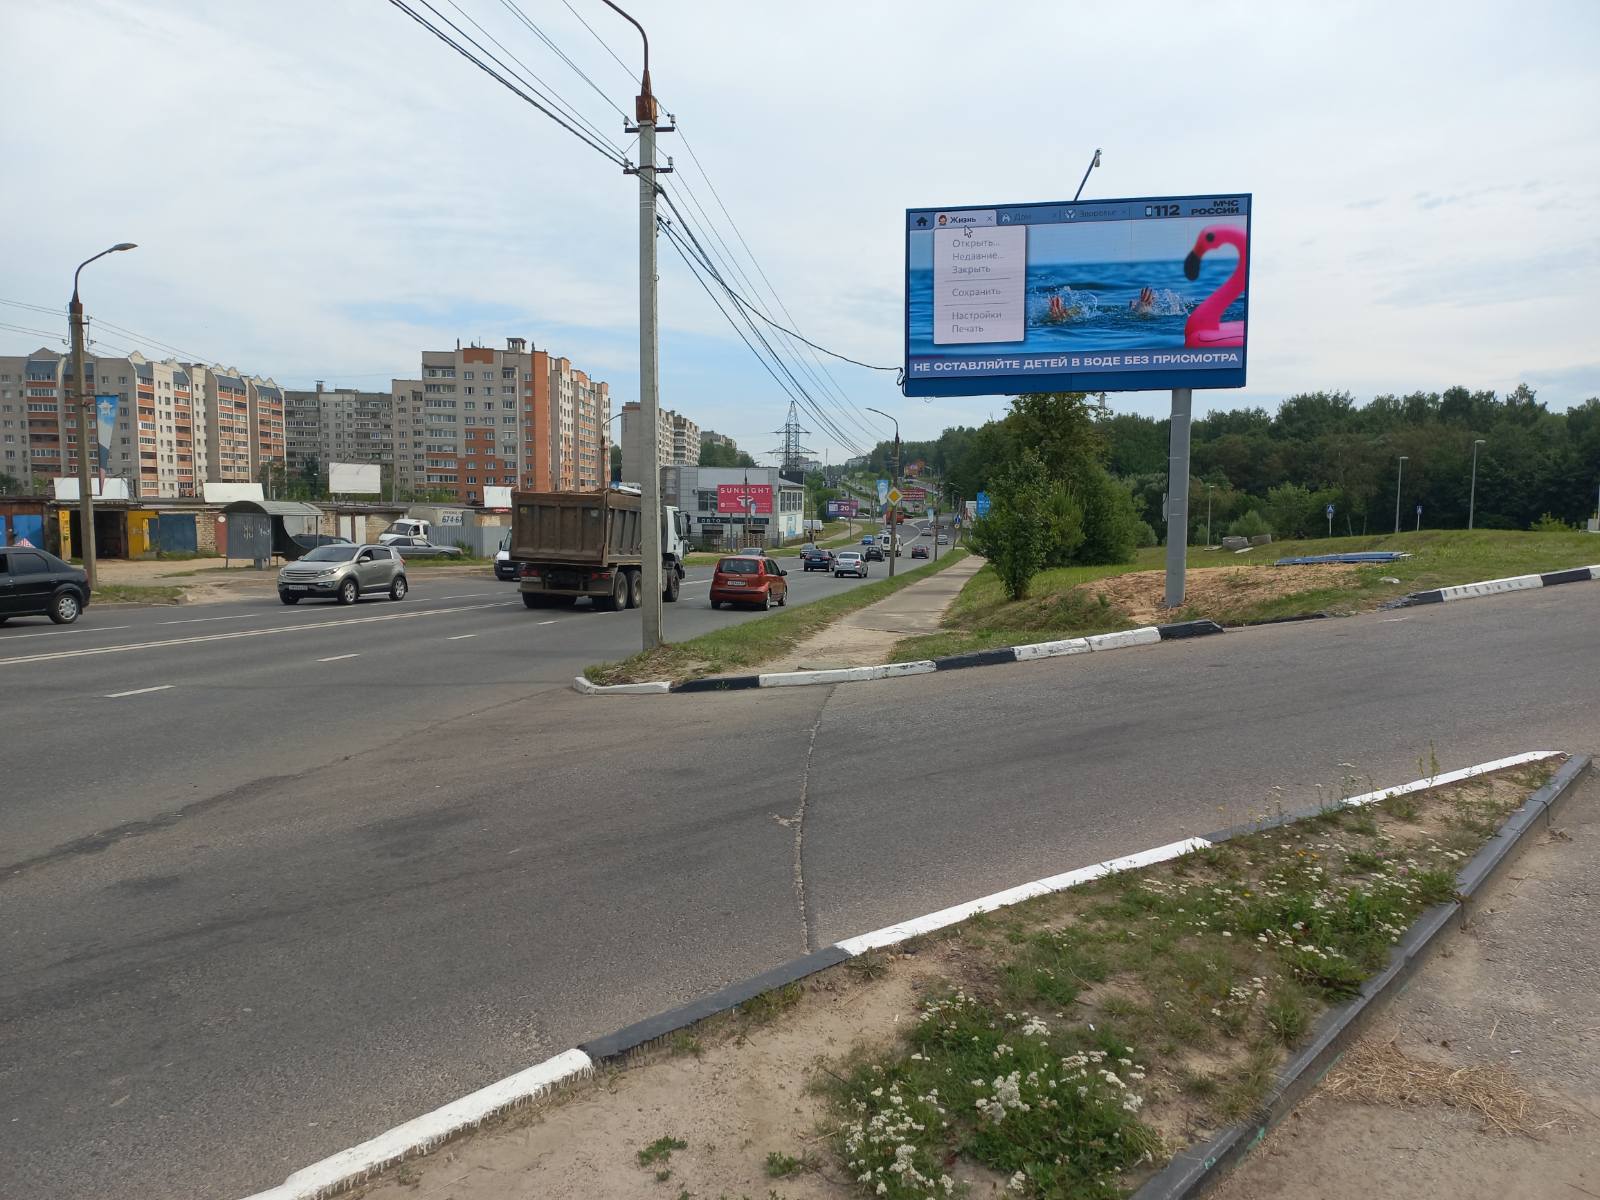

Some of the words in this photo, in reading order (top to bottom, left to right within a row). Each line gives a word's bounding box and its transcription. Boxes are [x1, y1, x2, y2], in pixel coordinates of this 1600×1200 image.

[1154, 204, 1180, 216] 112
[1191, 207, 1239, 216] РОССИИ
[950, 215, 977, 225] Жизнь
[952, 265, 990, 275] Закрыть
[952, 287, 1001, 297] Сохранить
[952, 310, 1002, 321] Настройки
[952, 324, 984, 334] Печать
[914, 362, 931, 372] НЕ
[934, 358, 1020, 371] ОСТАВЛЯЙТЕ
[1023, 356, 1068, 369] ДЕТЕЙ
[1071, 358, 1080, 367] В
[1084, 356, 1121, 367] ВОДЕ
[1124, 355, 1149, 365] БЕЗ
[1152, 353, 1239, 365] ПРИСМОТРА
